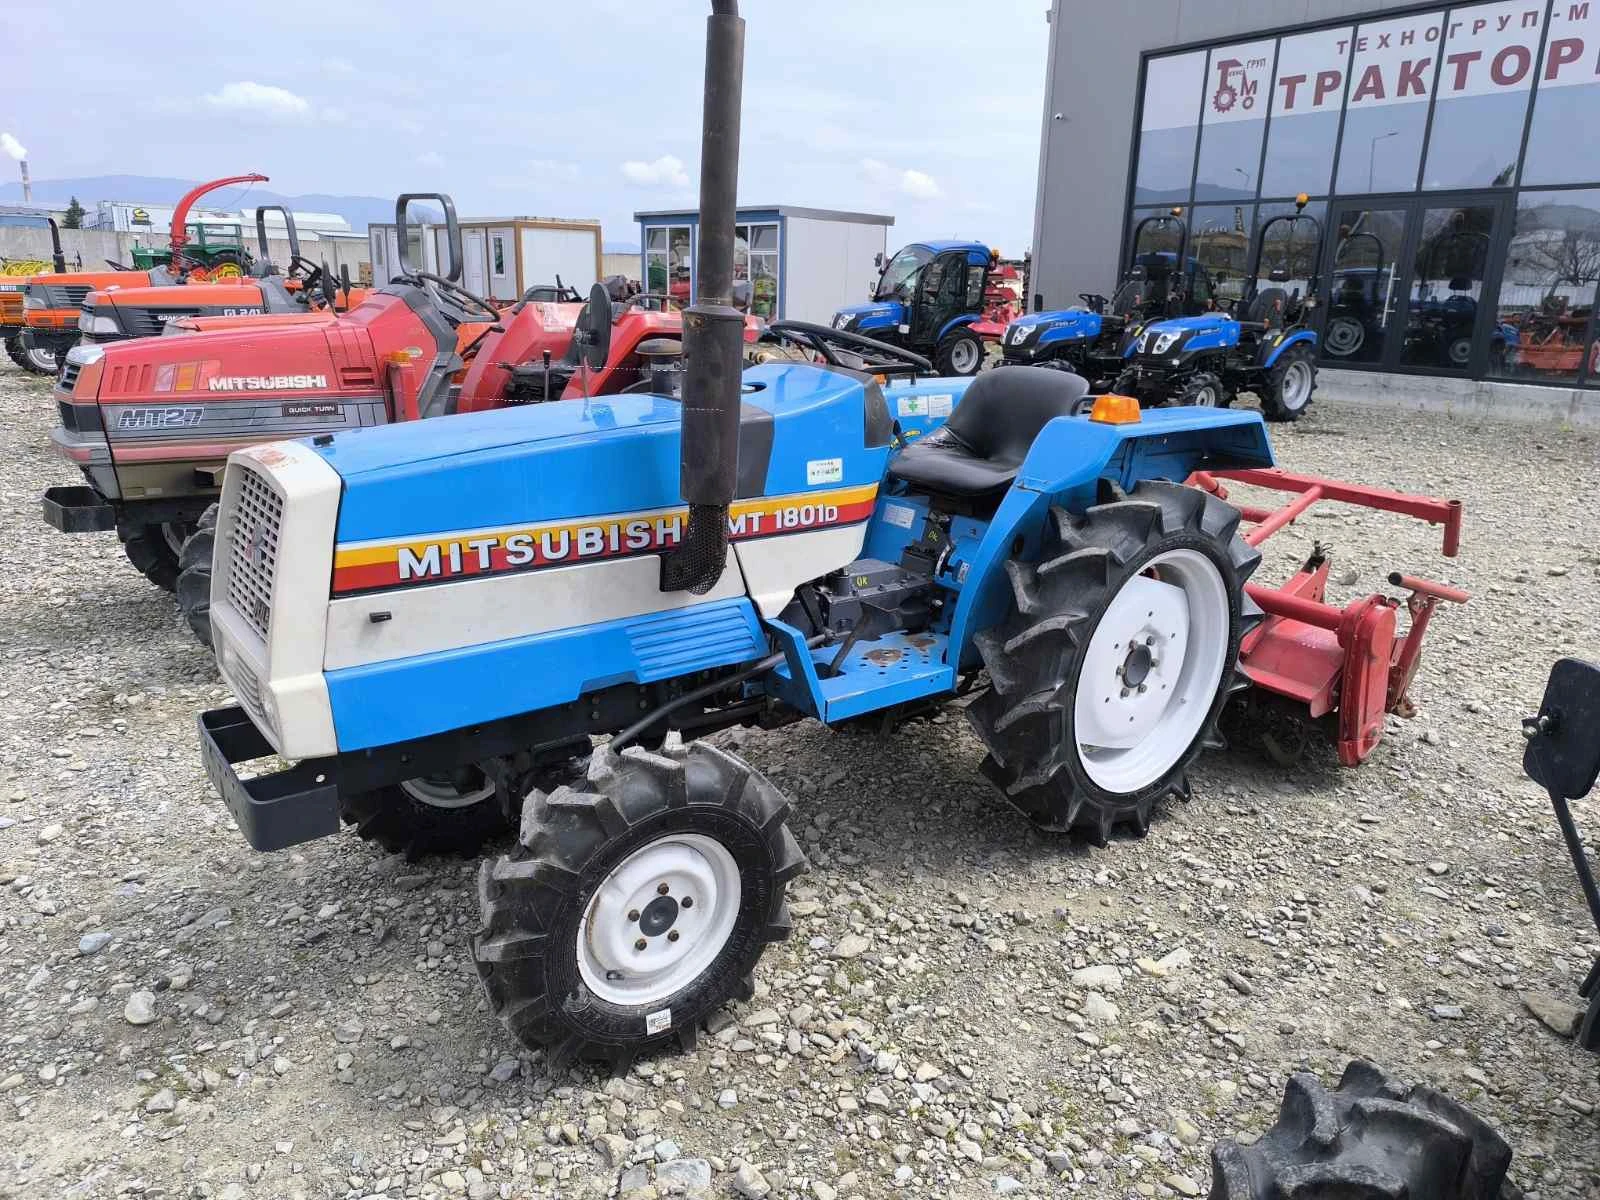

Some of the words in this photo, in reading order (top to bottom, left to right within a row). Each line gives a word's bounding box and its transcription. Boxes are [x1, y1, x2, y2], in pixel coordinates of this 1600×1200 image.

[1278, 37, 1600, 110] ТРАКТОР
[208, 375, 327, 391] MITSUBISHI
[118, 406, 205, 428] MT27
[397, 516, 682, 580] MITSUBISH
[774, 503, 839, 530] 1801D
